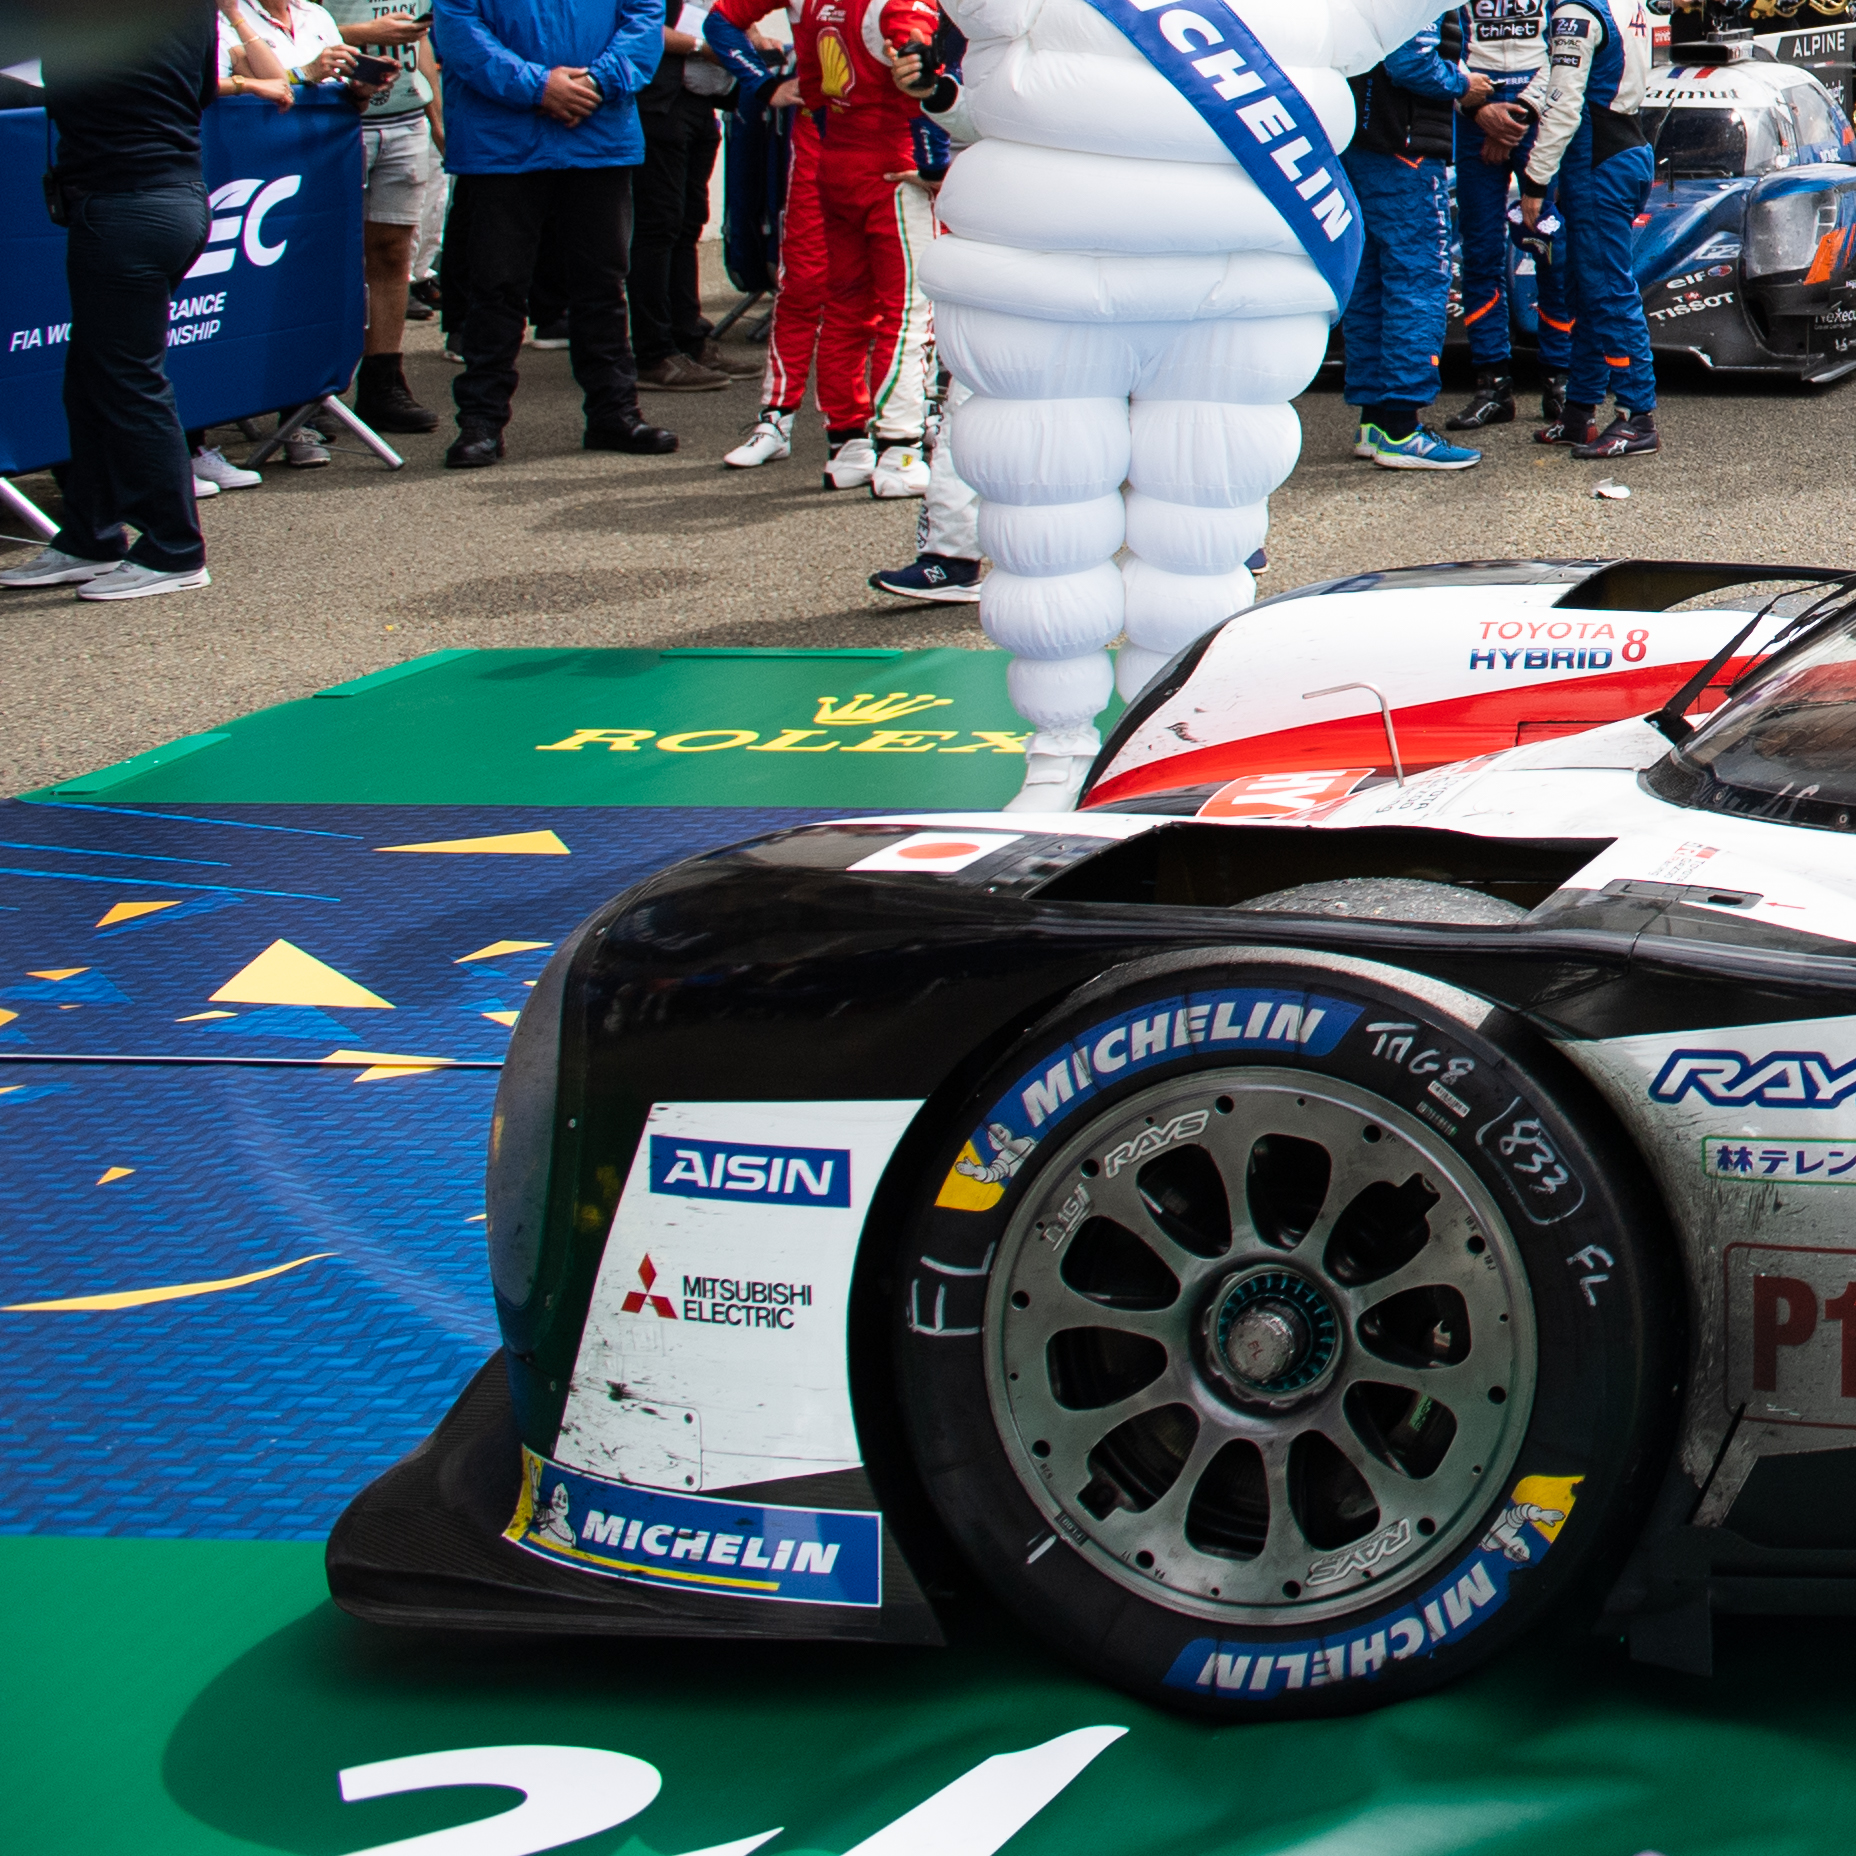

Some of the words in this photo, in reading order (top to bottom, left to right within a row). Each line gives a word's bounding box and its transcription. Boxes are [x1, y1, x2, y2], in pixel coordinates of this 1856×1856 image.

[1480, 24, 1536, 38] thiriet
[1793, 30, 1845, 58] ALPINE
[1666, 271, 1706, 290] elf
[1649, 292, 1736, 321] TISSOT
[10, 327, 42, 353] FIA
[1468, 646, 1614, 671] HYBRID
[1478, 619, 1616, 642] TOYOTA
[1620, 629, 1649, 663] 8
[535, 726, 1031, 756] ROLEX
[1021, 1000, 1327, 1131] MICHELIN
[1103, 1108, 1210, 1178] RAYS
[1508, 1115, 1572, 1196] 833
[660, 1148, 838, 1198] AISIN
[682, 1274, 814, 1305] MITSUBISHI
[908, 1239, 998, 1340] FL
[1566, 1243, 1615, 1307] FL
[682, 1302, 796, 1331] ELECTRIC
[581, 1507, 843, 1577] MICHELIN
[1306, 1518, 1414, 1588] RAYS
[1195, 1556, 1498, 1693] MICHELIN
